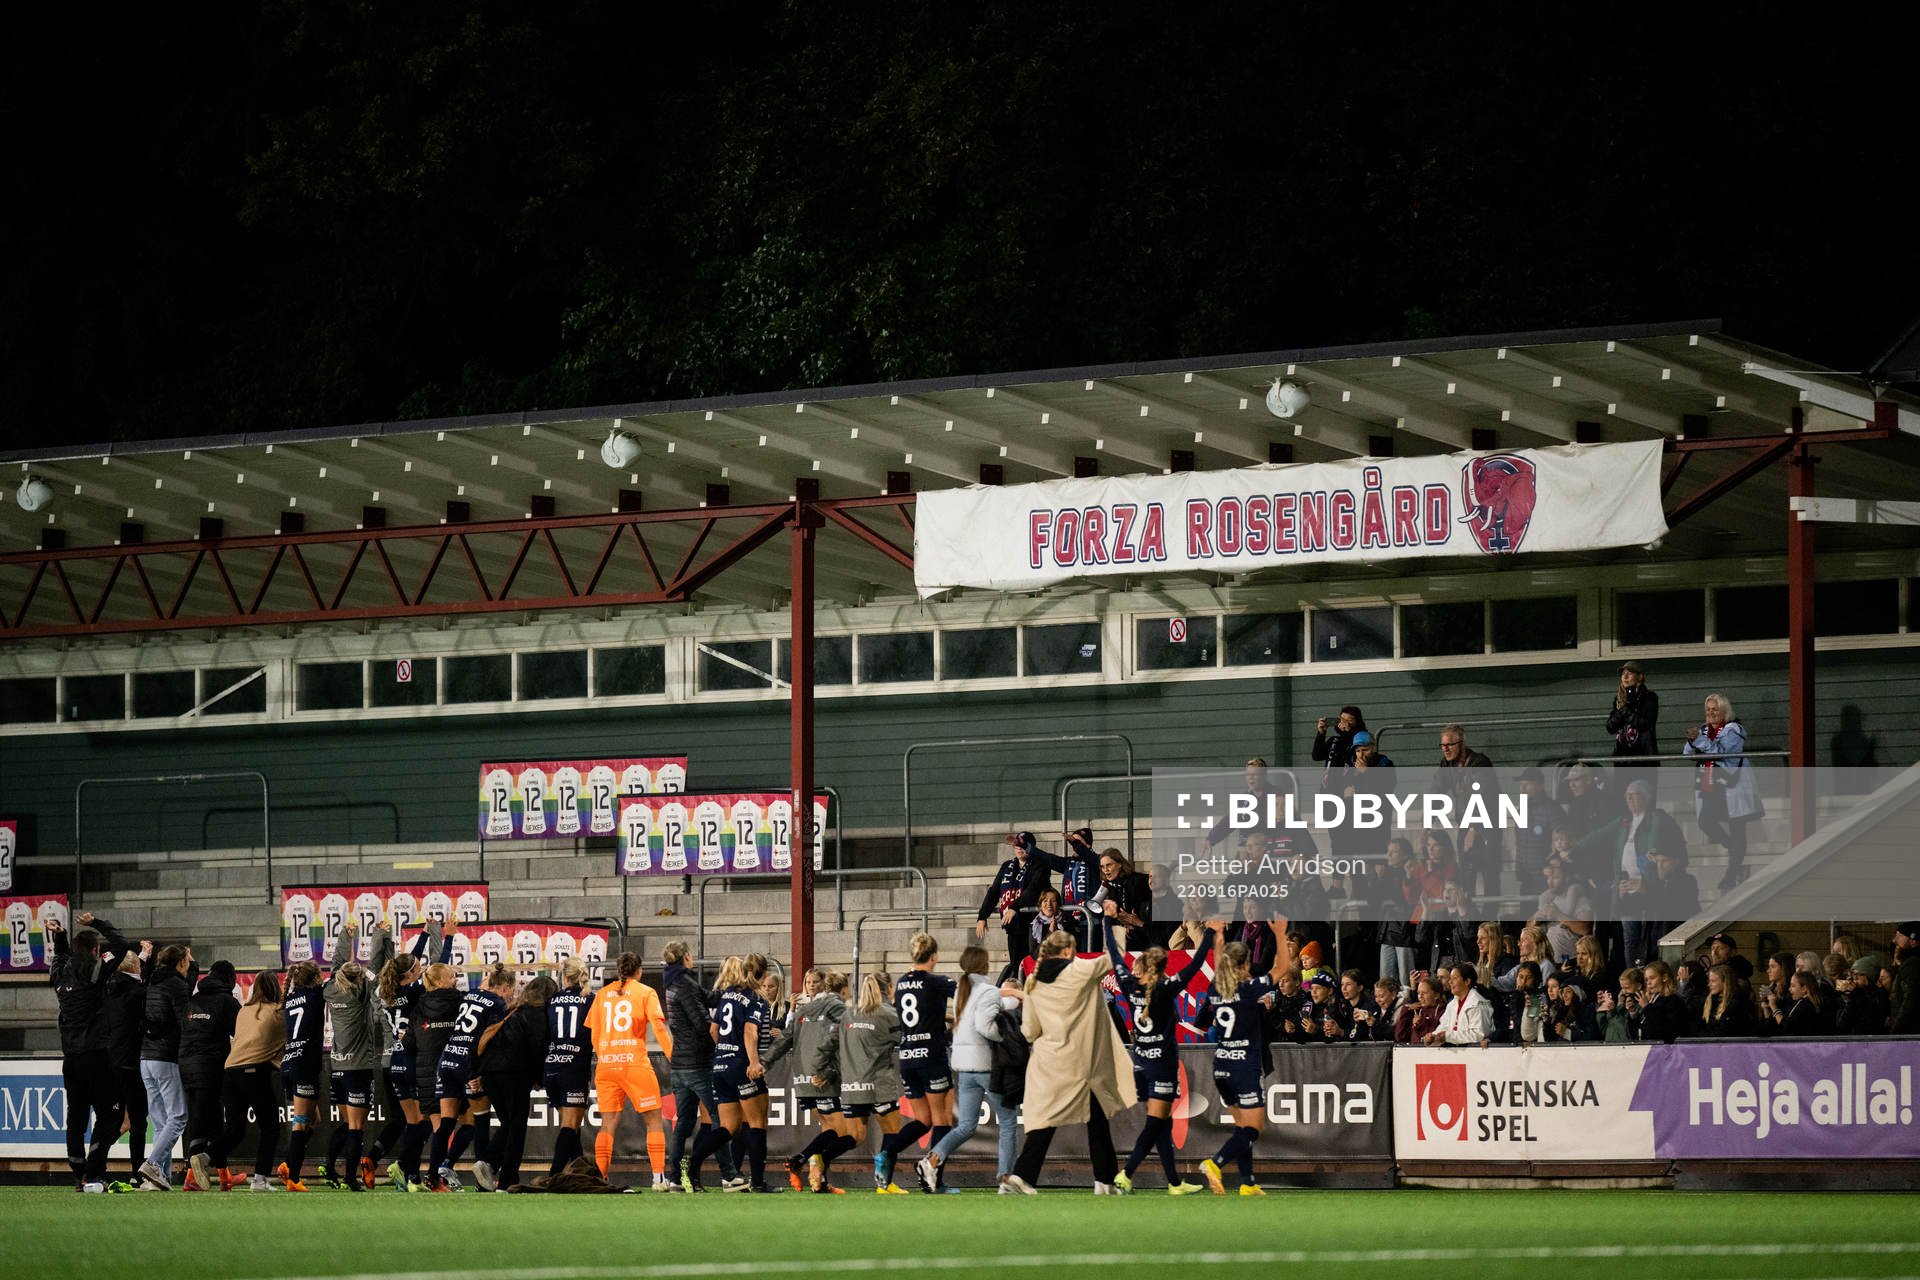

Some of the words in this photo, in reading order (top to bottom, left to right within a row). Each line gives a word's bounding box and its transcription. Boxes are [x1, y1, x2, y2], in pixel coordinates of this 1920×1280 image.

[1029, 503, 1167, 569] FORZA
[1186, 466, 1452, 558] ROSENGÅRD
[492, 788, 507, 812] 12
[525, 787, 540, 811] 12
[560, 786, 575, 810] 12
[593, 785, 609, 809] 12
[629, 823, 645, 848] 12
[666, 822, 681, 847] 12
[701, 821, 717, 846] 12
[737, 820, 753, 845] 12
[773, 820, 787, 845] 12
[11, 921, 26, 944] 12
[292, 913, 307, 938] 12
[326, 913, 341, 937] 12
[360, 912, 375, 937] 12
[285, 995, 307, 1009] BROWN
[550, 995, 587, 1004] LARSSON
[901, 993, 919, 1028] 8
[289, 1007, 304, 1039] 7
[454, 1002, 484, 1033] 25
[555, 1006, 578, 1038] 11
[603, 1000, 633, 1033] 18
[719, 1002, 733, 1036] 3
[1134, 1006, 1154, 1033] 6
[1216, 1006, 1236, 1038] 9
[1477, 1079, 1600, 1107] SVENSKA
[1688, 1062, 1800, 1139] Heja
[1811, 1063, 1913, 1126] alla!
[1478, 1114, 1538, 1142] SPEL
